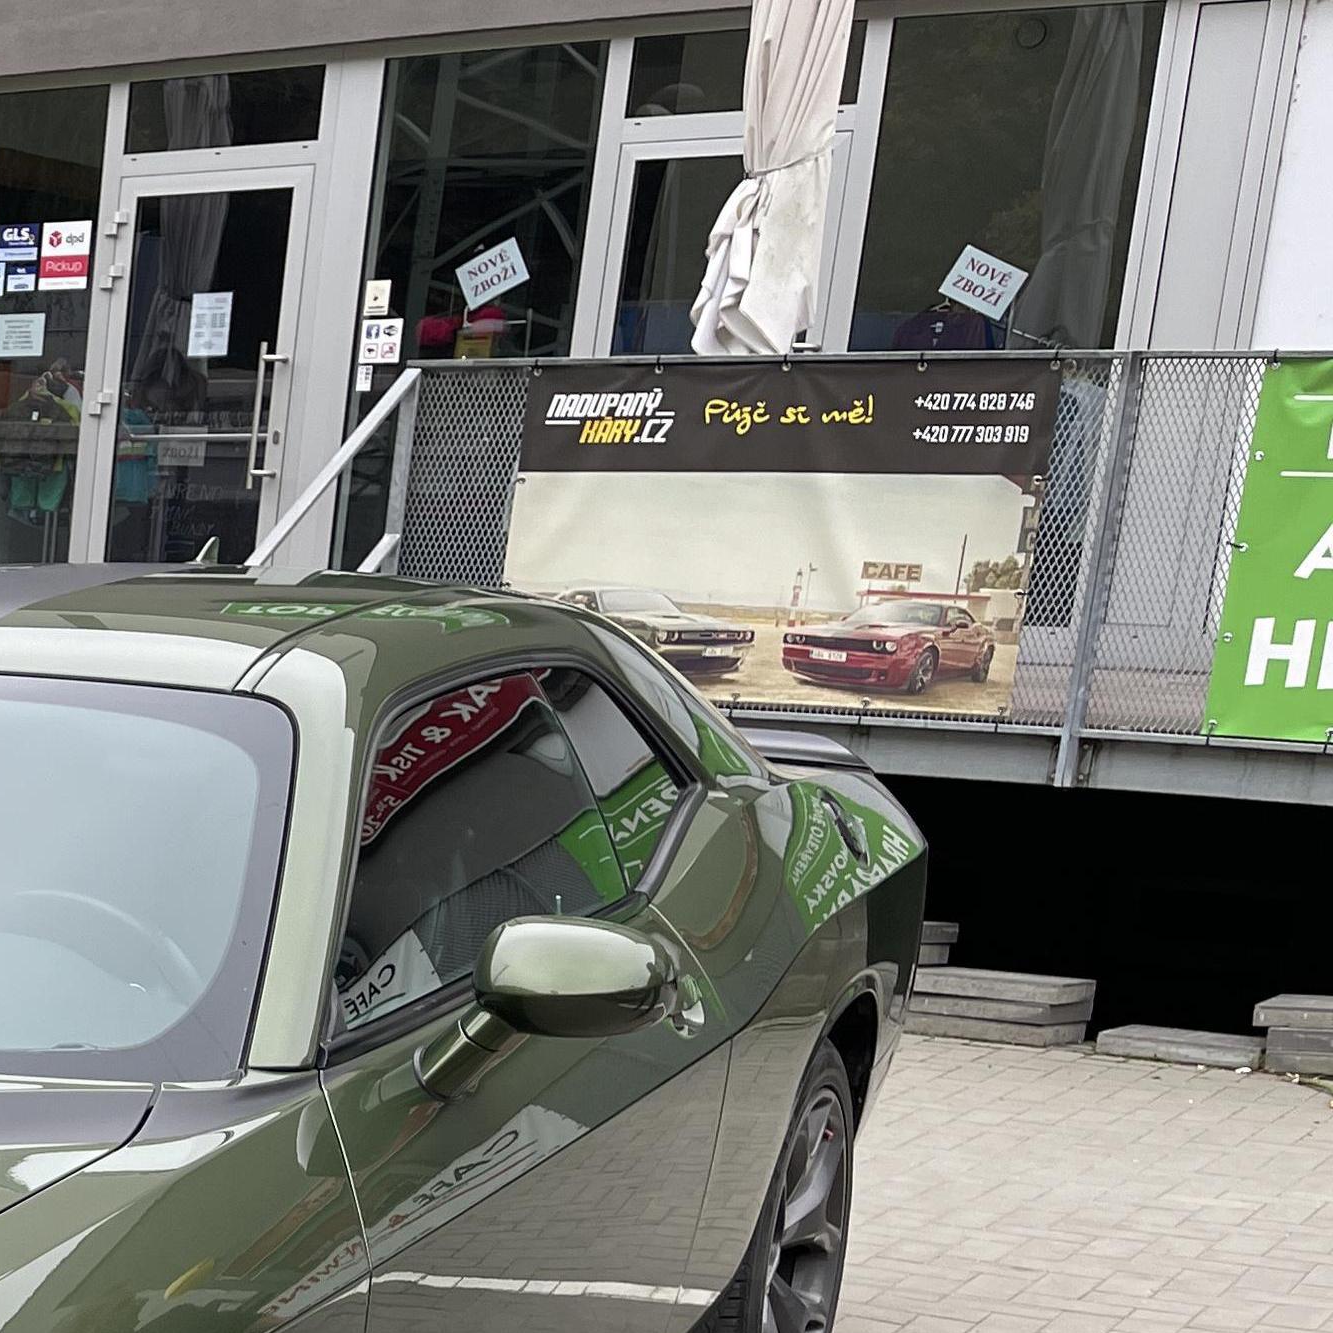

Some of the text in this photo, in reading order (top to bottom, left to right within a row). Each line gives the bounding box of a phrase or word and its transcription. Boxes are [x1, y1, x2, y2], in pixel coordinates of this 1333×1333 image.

[3, 227, 31, 241] GLS
[65, 232, 85, 245] dpd
[45, 261, 83, 273] Pickup
[467, 248, 511, 280] NOVÉ
[965, 256, 1013, 288] NOVÉ
[471, 263, 518, 298] ZBOŽÍ
[952, 274, 1006, 307] ZBOŽÍ
[546, 387, 664, 417] NADUPANÝ
[821, 394, 875, 424] mě!
[914, 392, 1036, 411] +420 774 828 746
[912, 425, 1030, 444] +420 777 303 919
[864, 561, 922, 583] CAFE
